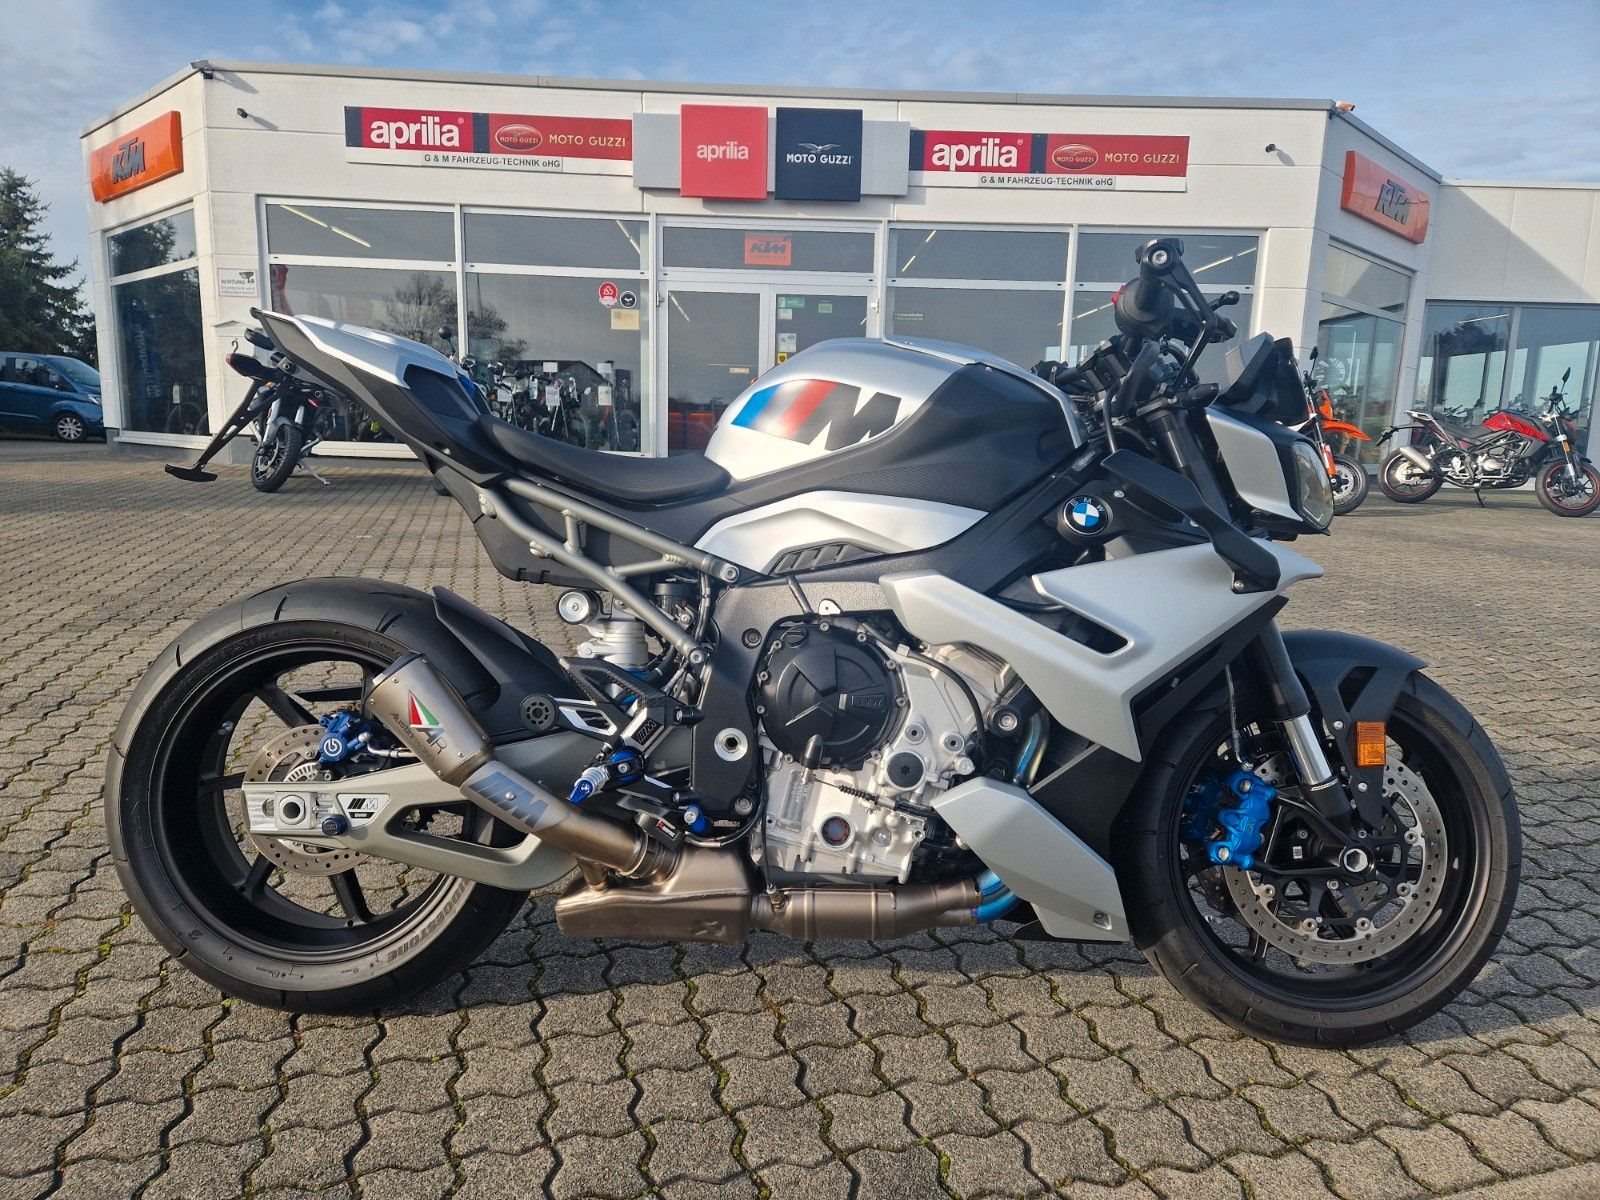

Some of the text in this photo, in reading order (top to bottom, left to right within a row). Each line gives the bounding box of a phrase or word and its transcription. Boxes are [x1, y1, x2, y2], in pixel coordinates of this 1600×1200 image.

[370, 116, 460, 149] aprilia
[549, 134, 625, 147] MOTO GUZZI
[697, 141, 749, 161] aprilia
[931, 138, 1018, 171] aprilia
[1104, 153, 1179, 164] MOTO GUZZI
[111, 137, 146, 184] KTM
[424, 154, 431, 162] G
[442, 155, 449, 163] M
[451, 155, 540, 167] FAHRZEUG-TECHNIK
[542, 159, 561, 168] oHG
[786, 153, 852, 165] MOTO GUZZI
[980, 176, 1113, 186] G & M FAHRZEUG-TECHNIK oHG
[1375, 179, 1410, 225] KTM
[751, 241, 787, 254] KTM
[1070, 497, 1105, 512] BMW
[387, 878, 472, 963] IDGESTONE
